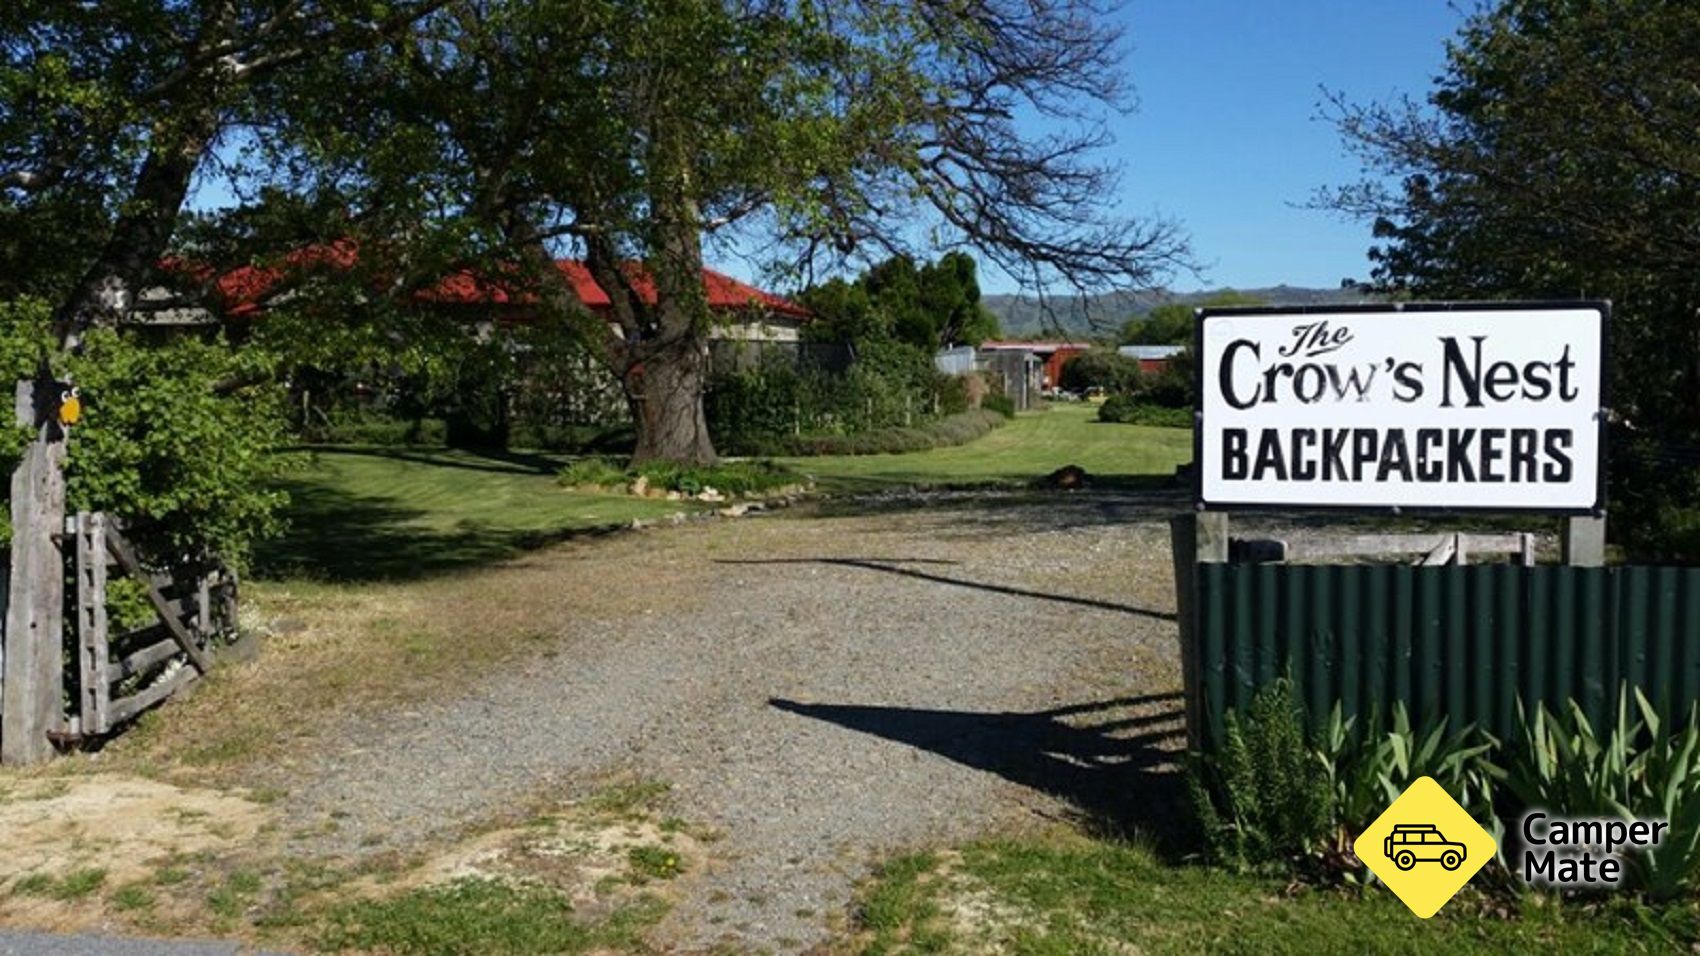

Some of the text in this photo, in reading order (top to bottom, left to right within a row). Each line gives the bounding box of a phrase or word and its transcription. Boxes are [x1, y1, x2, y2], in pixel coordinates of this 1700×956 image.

[1278, 320, 1355, 358] The
[1218, 335, 1579, 410] Crow's Nest
[1221, 427, 1573, 483] BACKPACKERS
